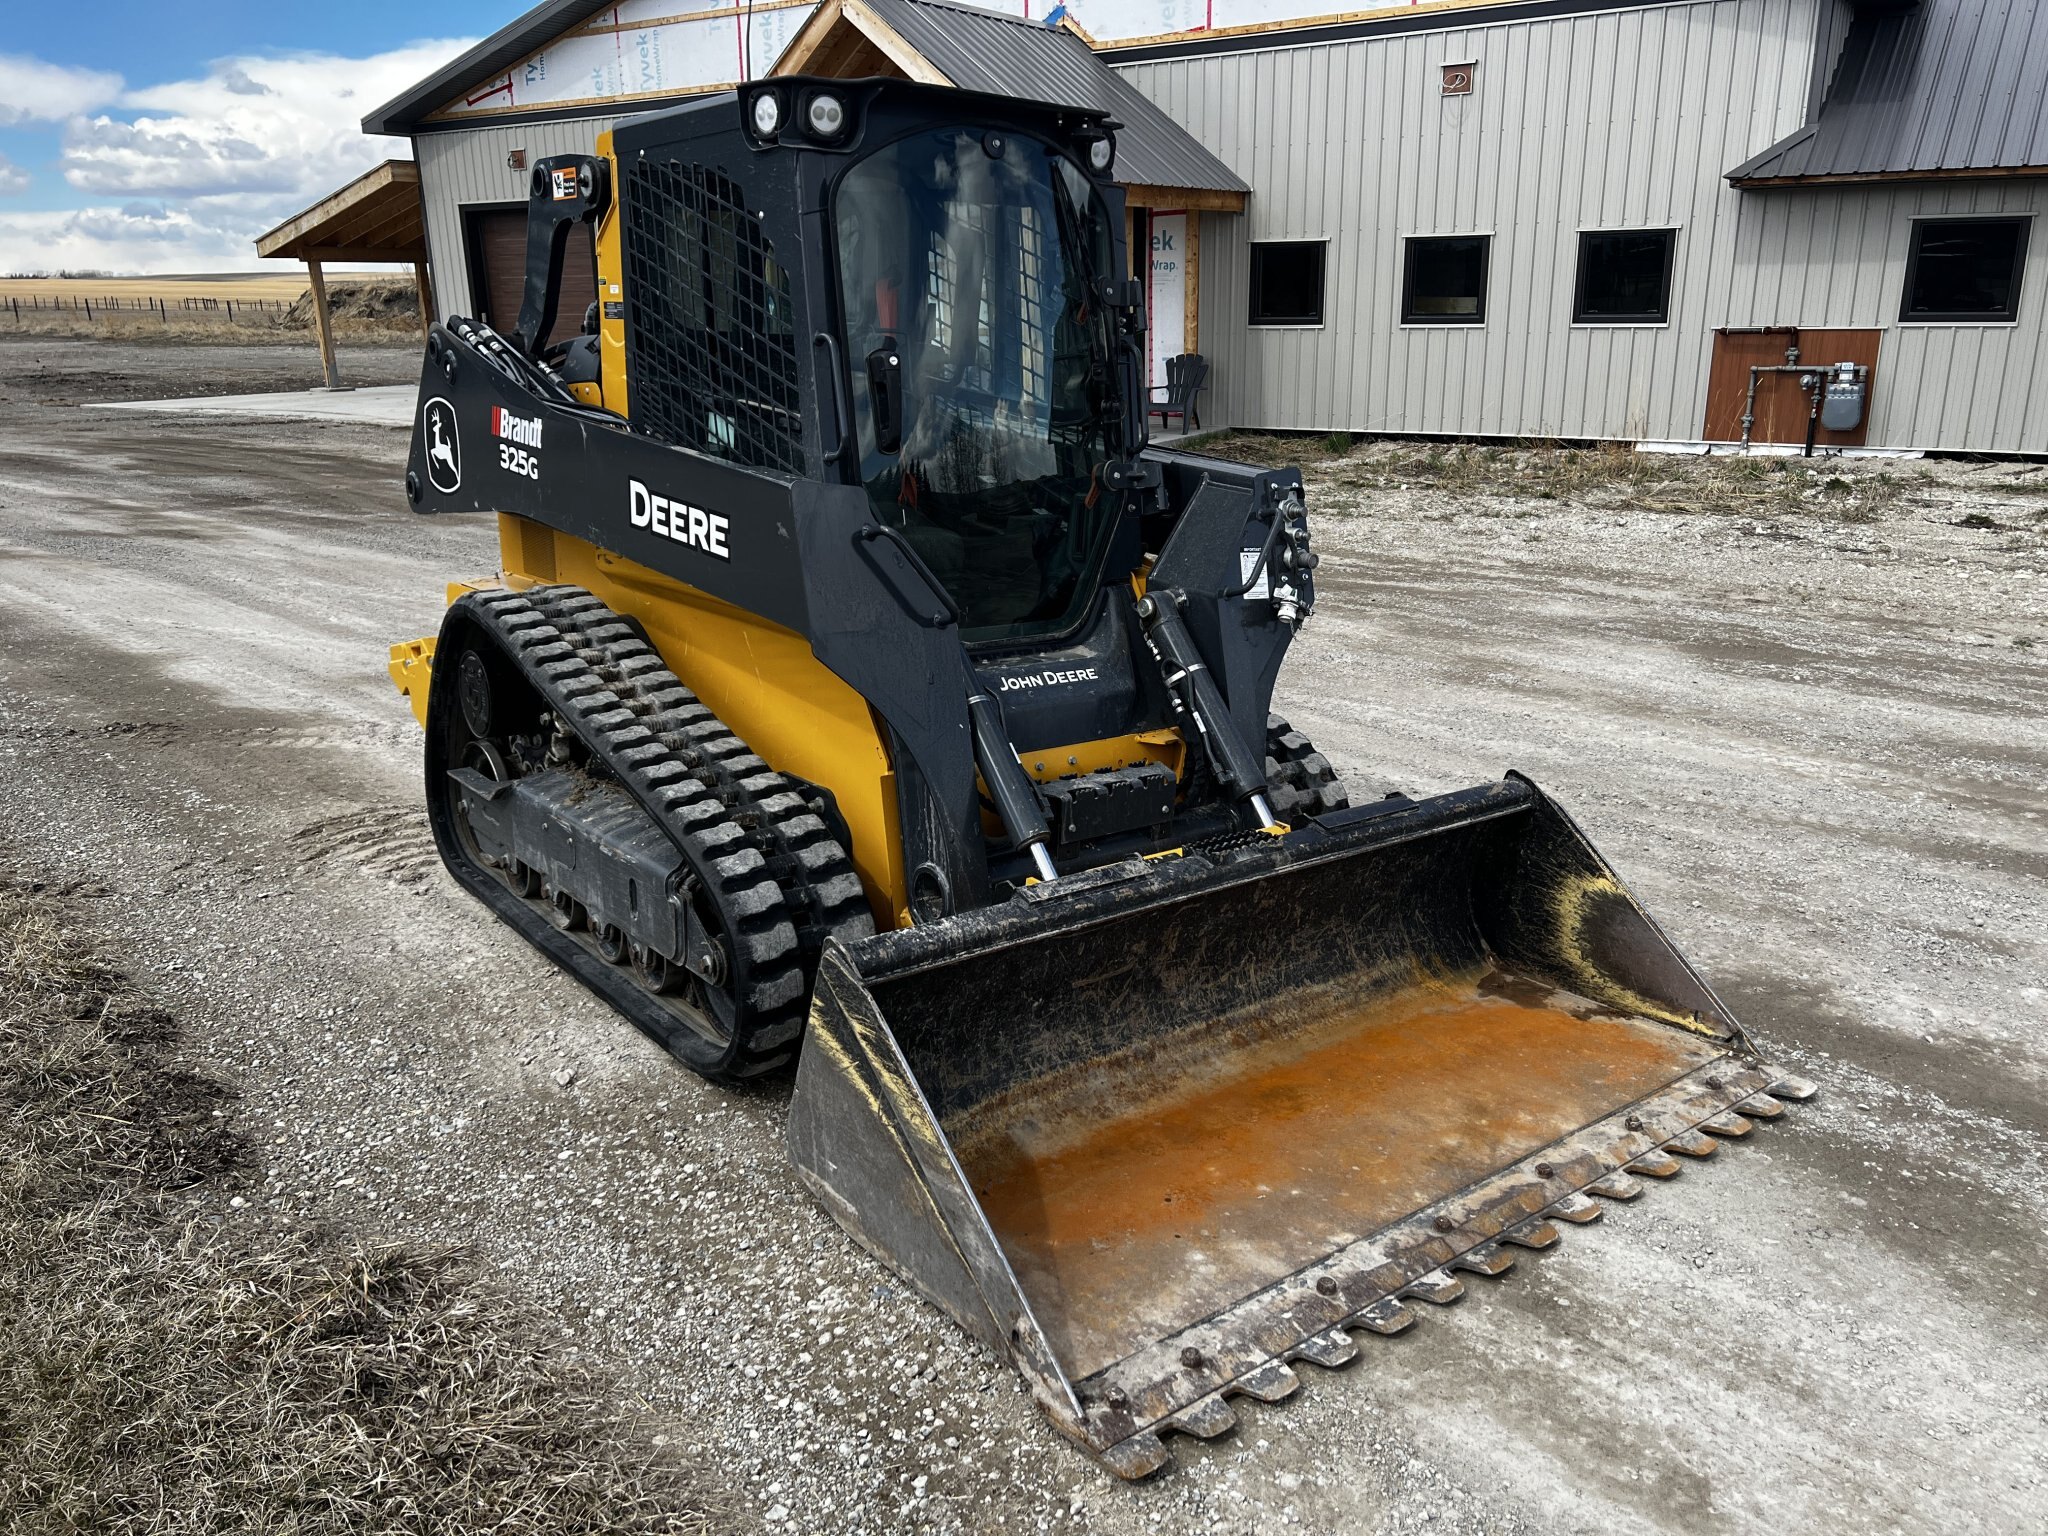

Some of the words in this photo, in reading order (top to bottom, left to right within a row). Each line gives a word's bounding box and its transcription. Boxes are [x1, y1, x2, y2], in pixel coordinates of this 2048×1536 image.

[1152, 230, 1174, 251] ek
[500, 407, 542, 449] Brandt
[499, 443, 539, 480] 325G
[629, 479, 729, 558] DEERE
[1000, 674, 1044, 691] JOHN
[1042, 668, 1099, 685] DEERE
